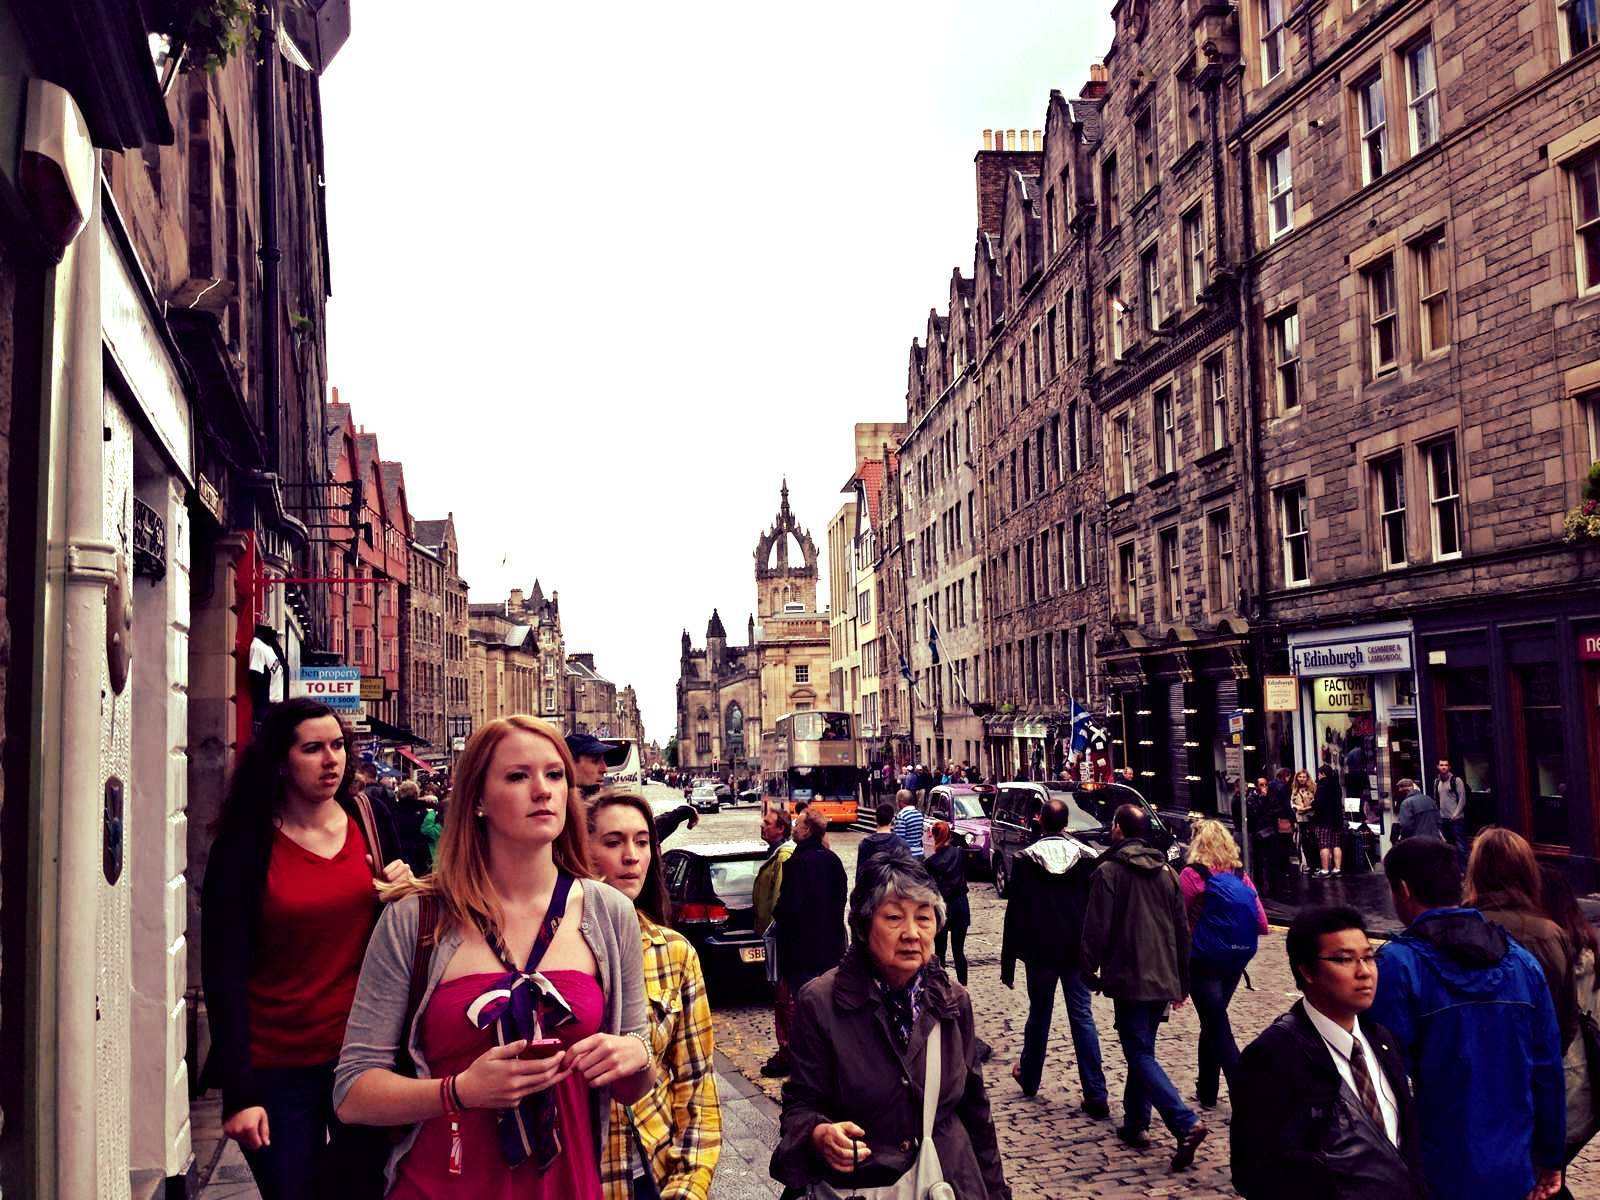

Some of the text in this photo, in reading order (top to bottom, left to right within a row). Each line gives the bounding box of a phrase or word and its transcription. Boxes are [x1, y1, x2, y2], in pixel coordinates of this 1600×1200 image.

[1303, 646, 1363, 668] Edinburgh
[305, 683, 325, 693] TO
[328, 683, 354, 693] LET
[1324, 678, 1367, 691] FACTORY
[1328, 694, 1365, 706] OUTLET
